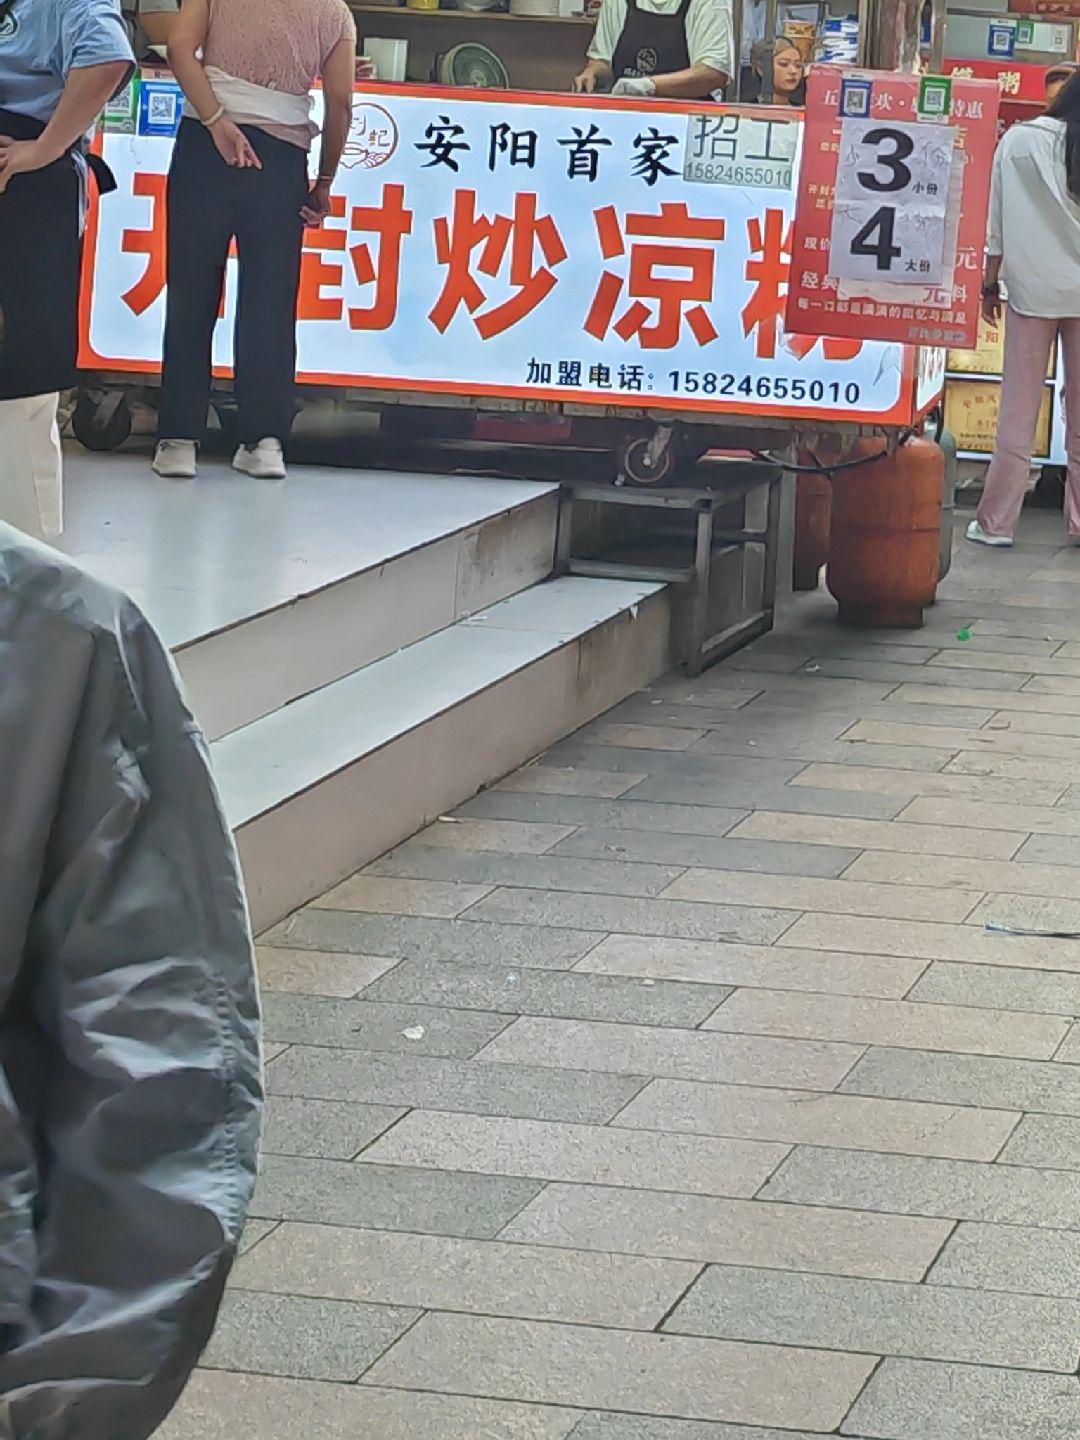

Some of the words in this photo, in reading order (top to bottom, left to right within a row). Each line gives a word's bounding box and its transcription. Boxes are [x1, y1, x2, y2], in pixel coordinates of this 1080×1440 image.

[413, 114, 681, 187] 安阳首家
[692, 112, 791, 163] 招工
[686, 162, 792, 186] 15824655010
[857, 128, 914, 192] 3
[912, 182, 938, 196] 小份
[850, 206, 901, 270] 4
[905, 259, 931, 273] 大份
[668, 369, 861, 405] 15824655010
